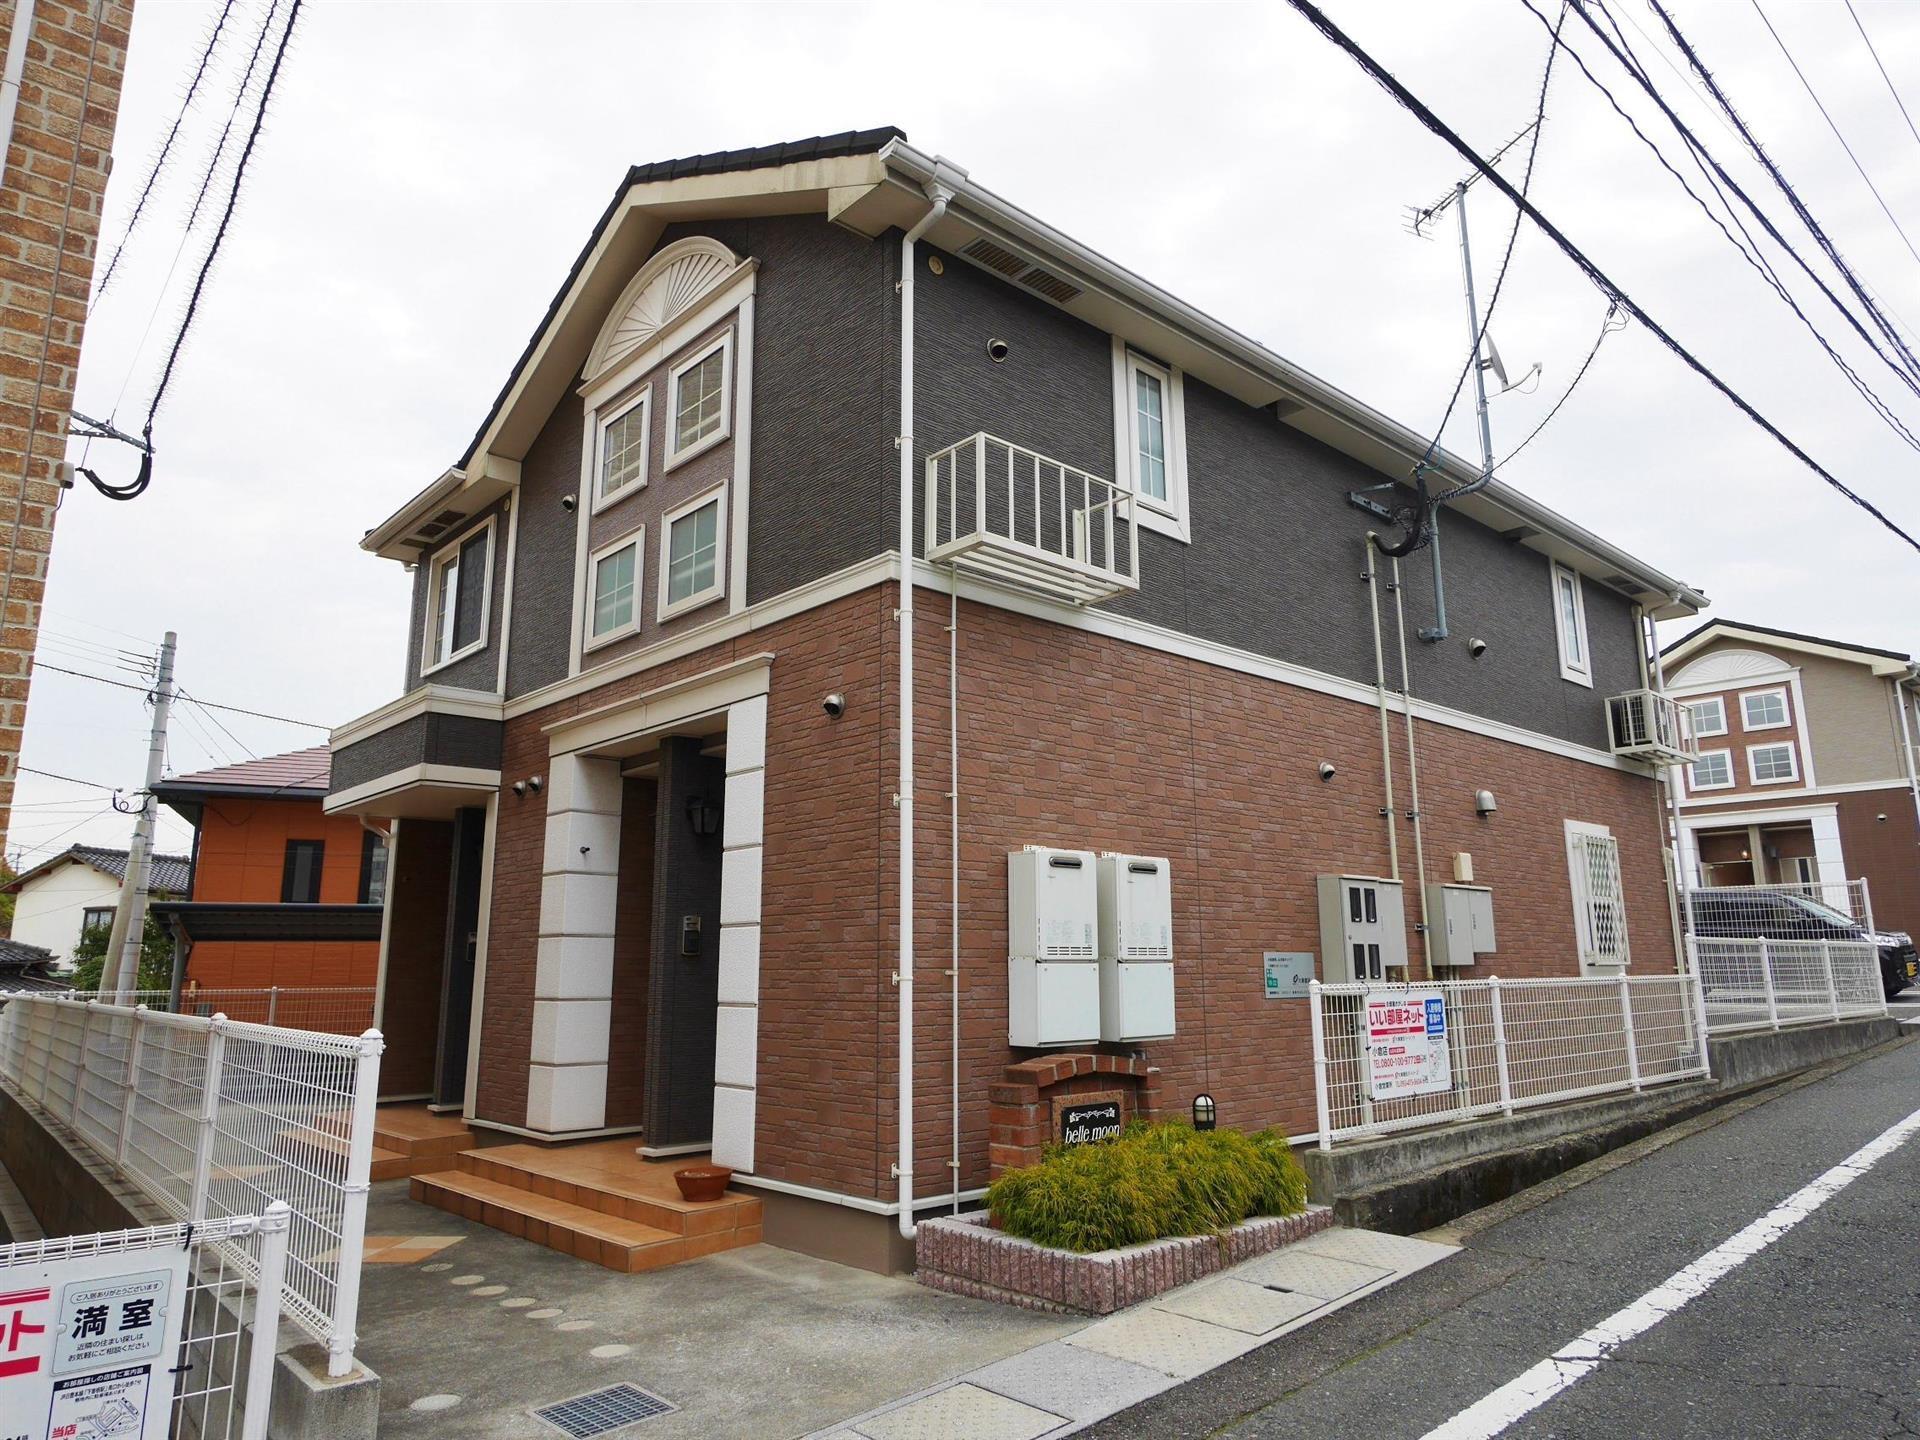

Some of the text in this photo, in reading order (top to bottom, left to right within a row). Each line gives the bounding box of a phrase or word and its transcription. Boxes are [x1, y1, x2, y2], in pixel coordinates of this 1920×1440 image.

[1369, 1007, 1424, 1026] いい部屋ネット
[1065, 1125, 1090, 1145] belle
[75, 1283, 159, 1302] ご入居ありがとうございます
[71, 1298, 155, 1340] 満室
[67, 1341, 150, 1362] お気軽にご相談ください
[76, 1333, 144, 1352] 近隣の住まい探しは
[51, 1424, 77, 1439] 当店
